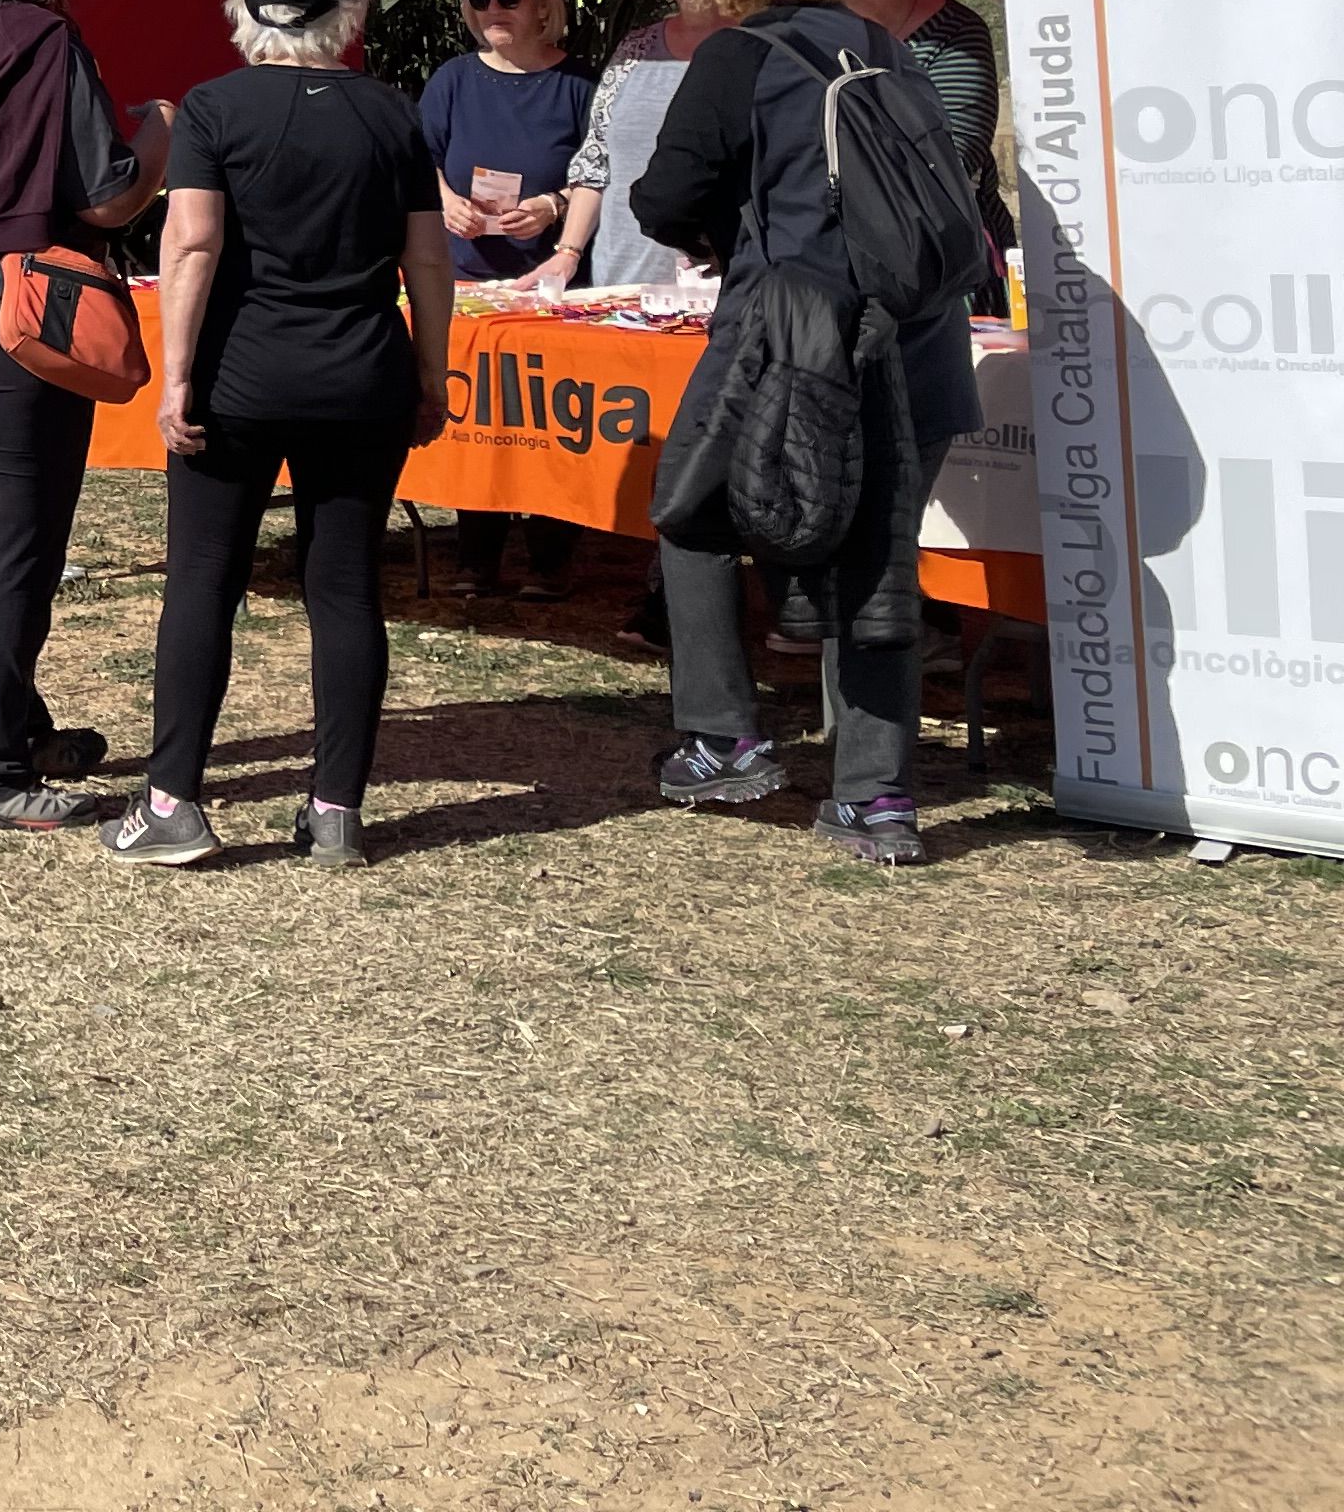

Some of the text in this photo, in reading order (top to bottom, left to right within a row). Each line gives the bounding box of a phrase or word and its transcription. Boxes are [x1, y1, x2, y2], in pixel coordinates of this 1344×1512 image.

[1029, 15, 1086, 204] d'Ajuda
[1120, 165, 1215, 185] Fundació
[1224, 165, 1273, 186] Lliga
[1046, 217, 1096, 426] Catalana
[1059, 443, 1112, 552] Lliga
[1064, 575, 1118, 786] Fundació
[1204, 740, 1340, 796] onc
